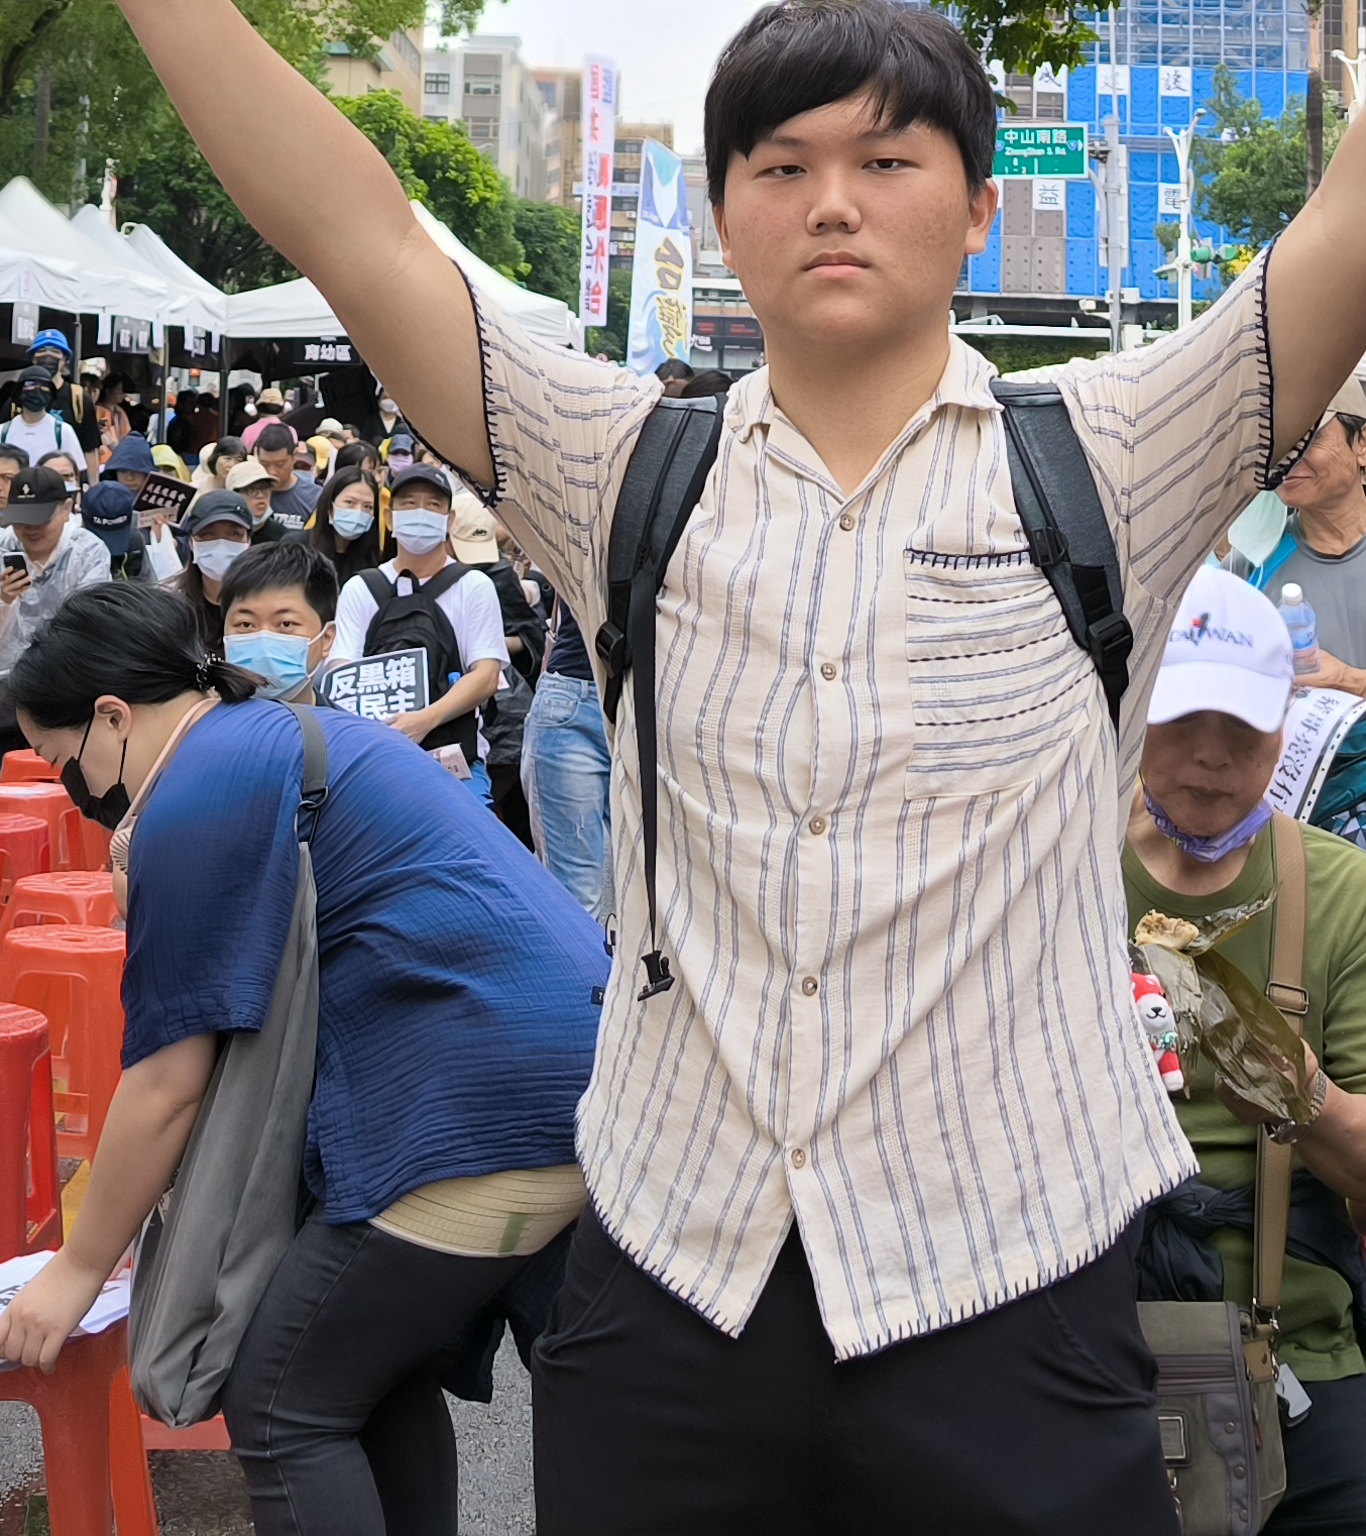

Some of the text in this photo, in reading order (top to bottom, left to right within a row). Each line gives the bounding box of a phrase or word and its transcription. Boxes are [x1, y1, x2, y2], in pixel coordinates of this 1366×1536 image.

[1004, 128, 1068, 145] 中山南路
[328, 656, 417, 701] 反黑箱
[1269, 694, 1340, 812] 豬哥亮沒有
